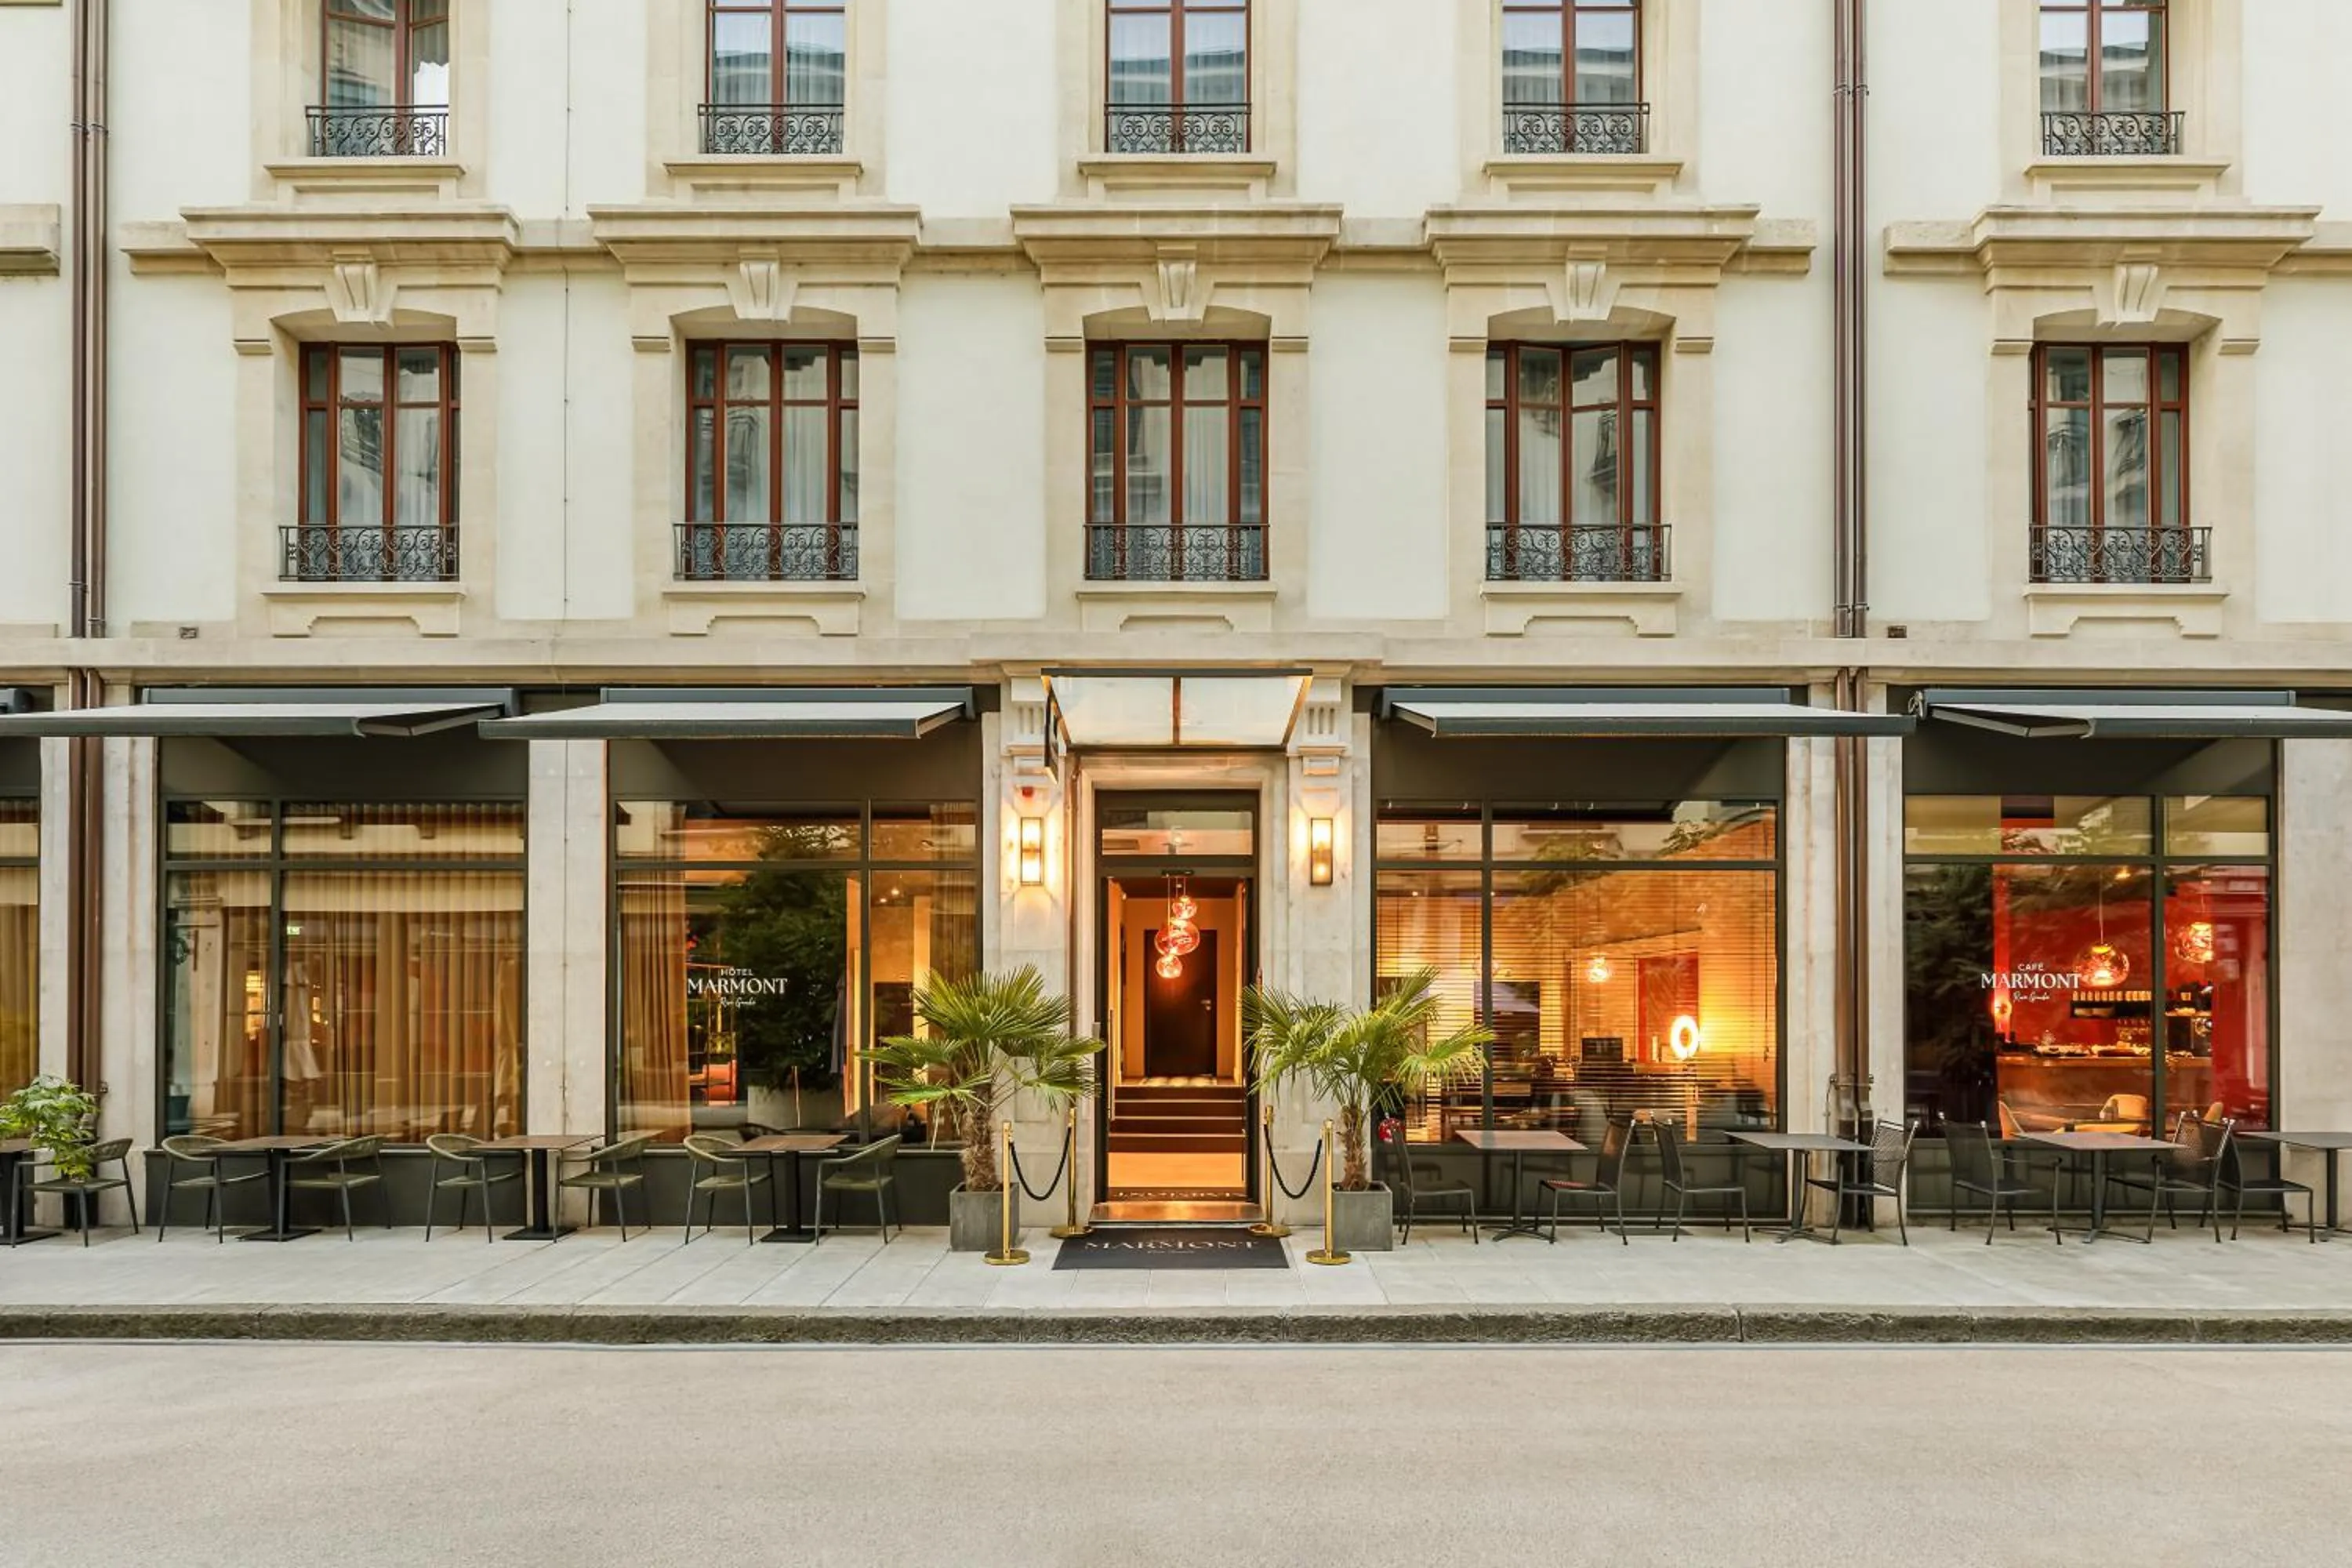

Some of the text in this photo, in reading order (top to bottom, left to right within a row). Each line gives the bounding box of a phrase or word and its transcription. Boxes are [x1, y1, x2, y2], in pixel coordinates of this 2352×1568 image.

[688, 978, 788, 994] MARMONT
[1981, 973, 2082, 989] MARMONT
[1084, 1241, 1258, 1250] MARMONT
